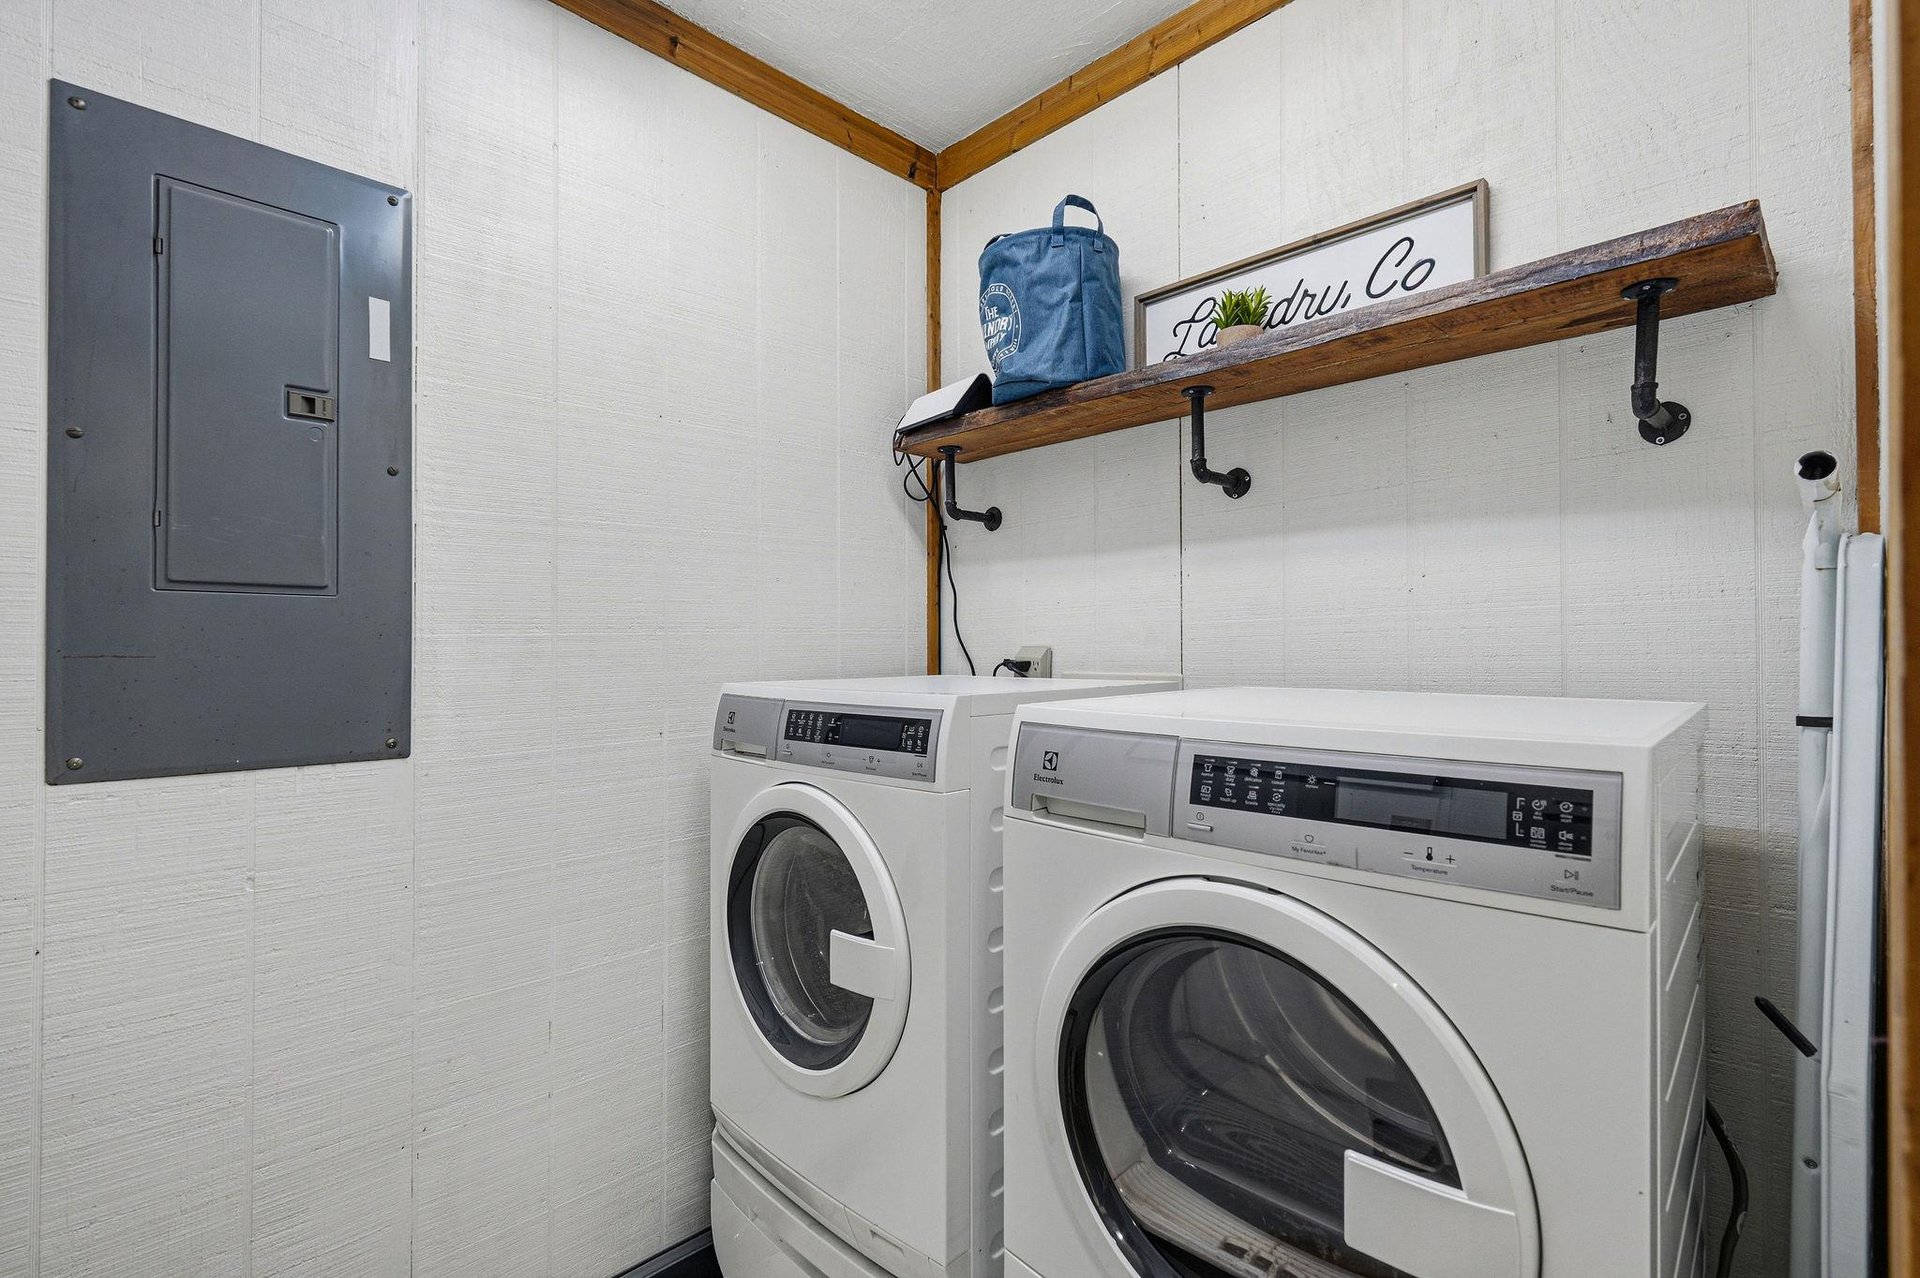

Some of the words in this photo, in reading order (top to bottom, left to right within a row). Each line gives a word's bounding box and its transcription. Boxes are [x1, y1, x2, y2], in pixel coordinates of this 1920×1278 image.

[1366, 236, 1436, 299] Co
[985, 306, 999, 320] THE
[1034, 773, 1064, 785] Electrolux
[1411, 864, 1449, 875] Temperature
[1550, 884, 1594, 897] Start/Pause
